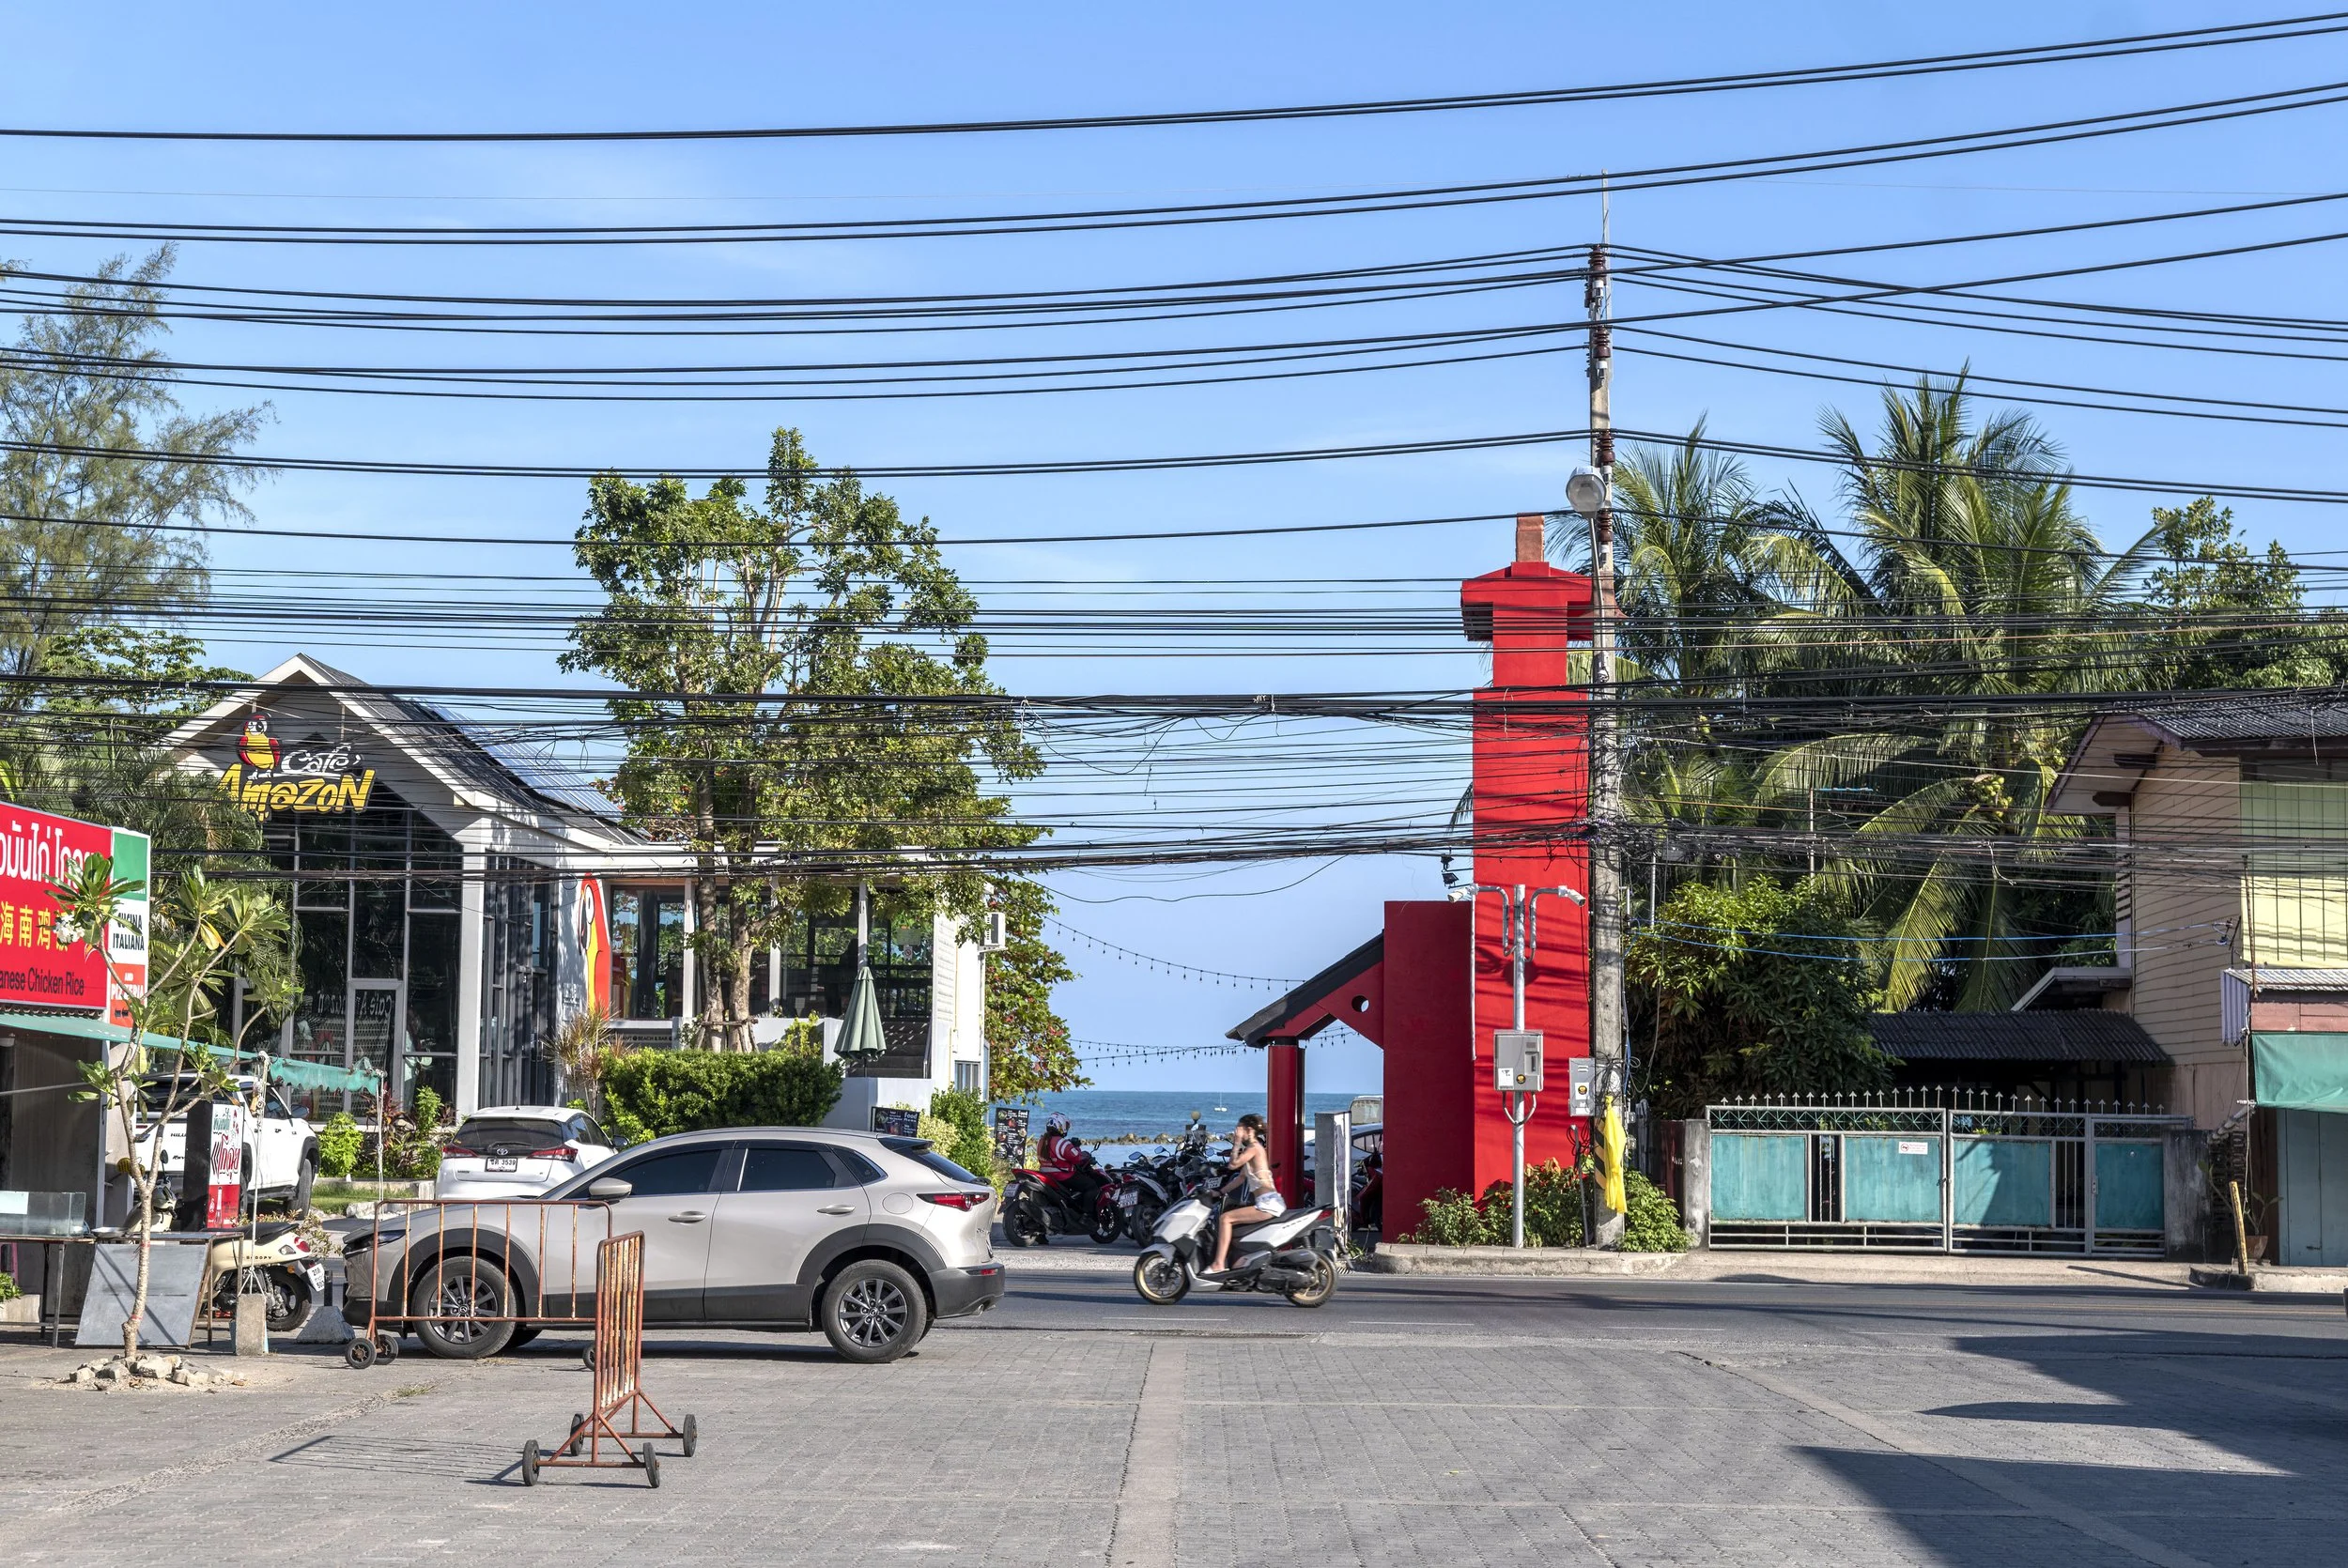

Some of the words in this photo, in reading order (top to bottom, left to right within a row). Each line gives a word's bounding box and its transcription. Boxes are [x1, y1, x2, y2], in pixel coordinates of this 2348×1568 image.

[0, 900, 70, 952] 海南鸡
[117, 912, 143, 930] CUCINA
[113, 932, 145, 951] ITALIANA
[27, 967, 64, 995] Chicken
[66, 971, 85, 996] Rice
